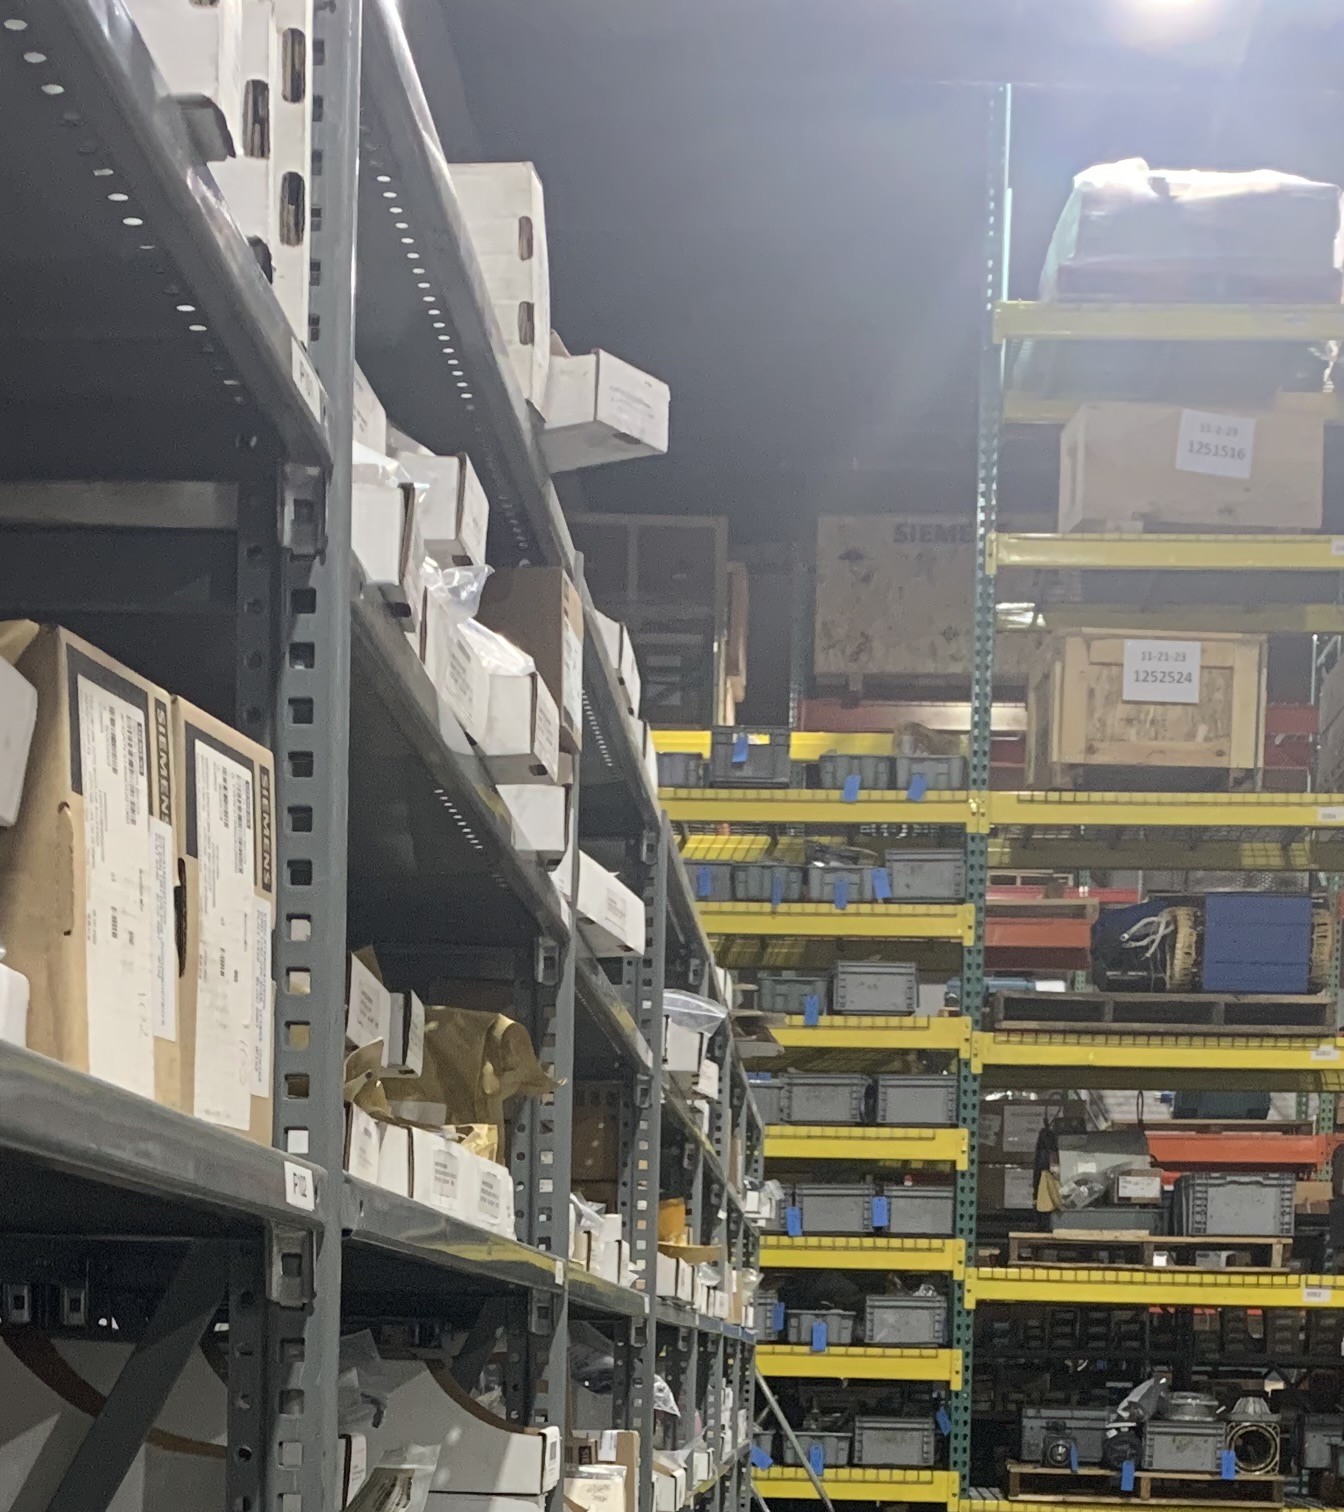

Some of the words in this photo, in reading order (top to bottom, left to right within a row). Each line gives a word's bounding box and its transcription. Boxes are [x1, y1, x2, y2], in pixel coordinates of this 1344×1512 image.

[1187, 440, 1246, 460] 1251516
[1133, 669, 1193, 684] 1252524
[259, 768, 271, 886] SIEMENS
